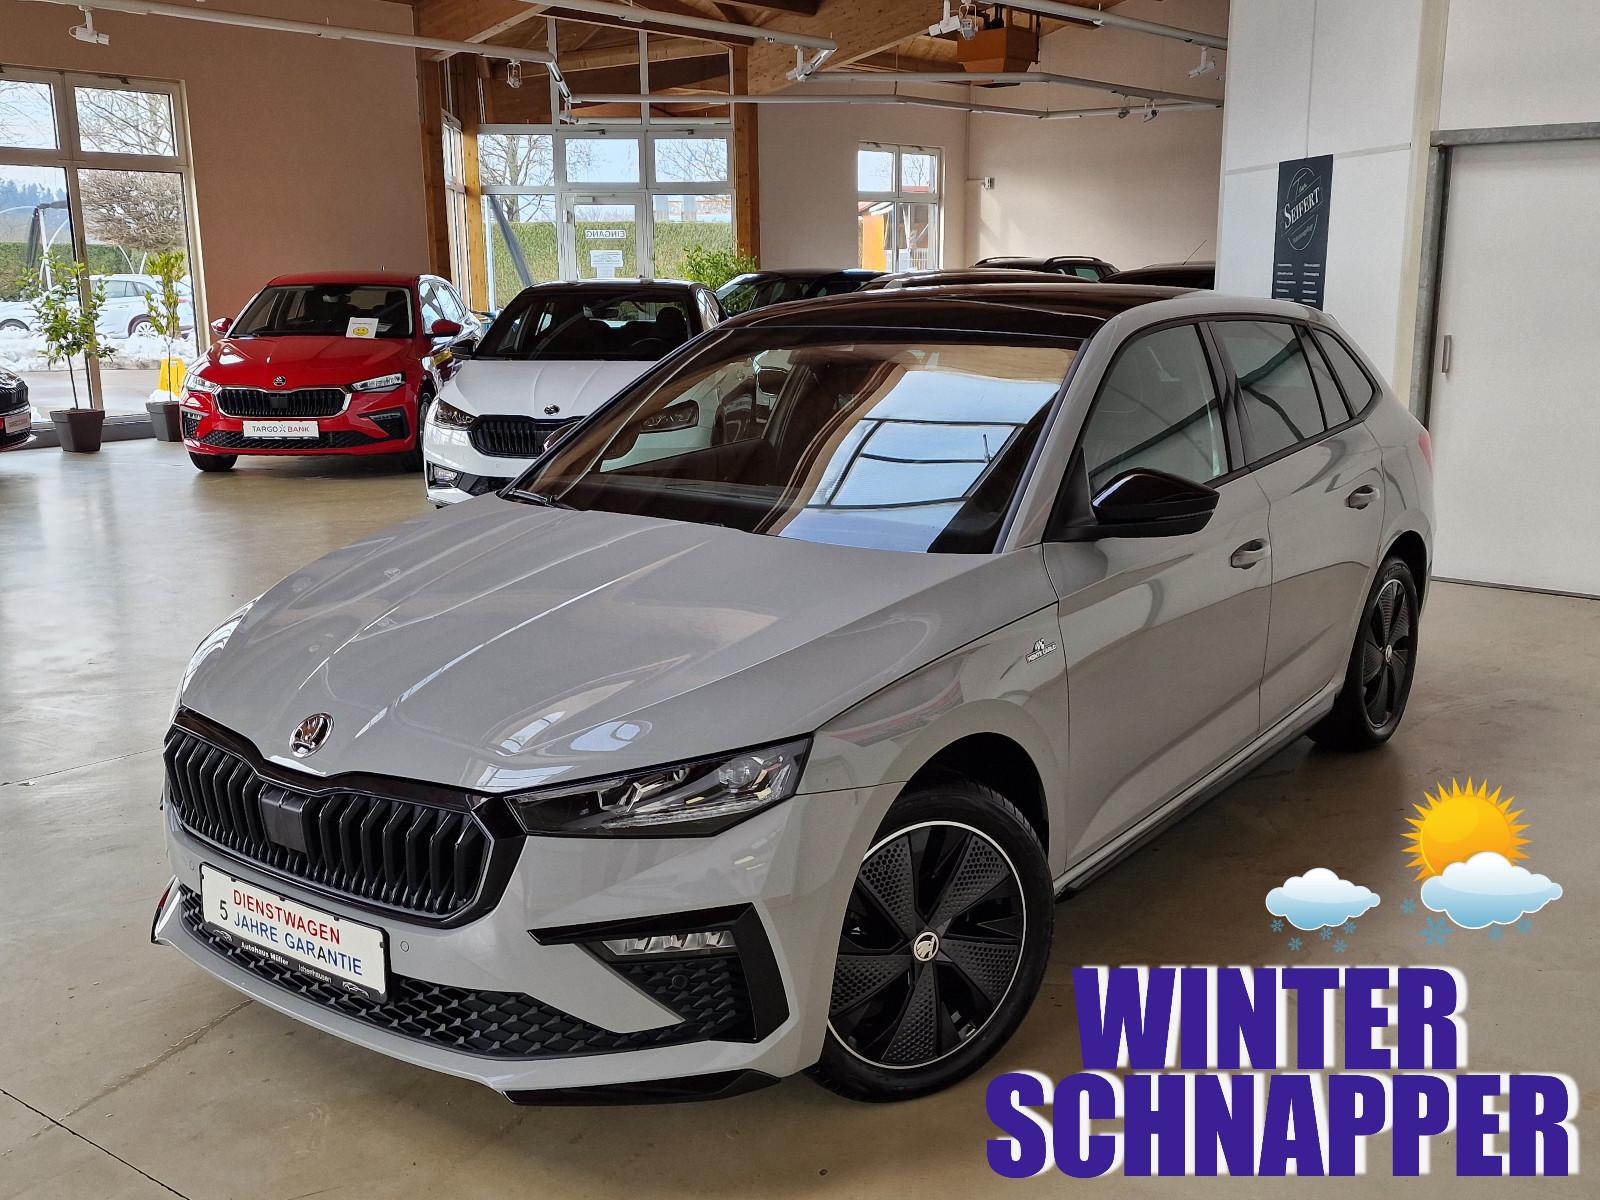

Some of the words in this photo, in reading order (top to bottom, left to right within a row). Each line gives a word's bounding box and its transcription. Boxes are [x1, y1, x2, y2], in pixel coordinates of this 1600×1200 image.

[1284, 187, 1320, 230] SEIFERT
[219, 900, 229, 921] 5
[234, 912, 279, 943] JAHRE
[284, 932, 363, 976] GARANTIE
[233, 889, 341, 945] DIENSTWAGEN
[241, 941, 270, 958] Autohaus
[270, 952, 289, 966] Müller
